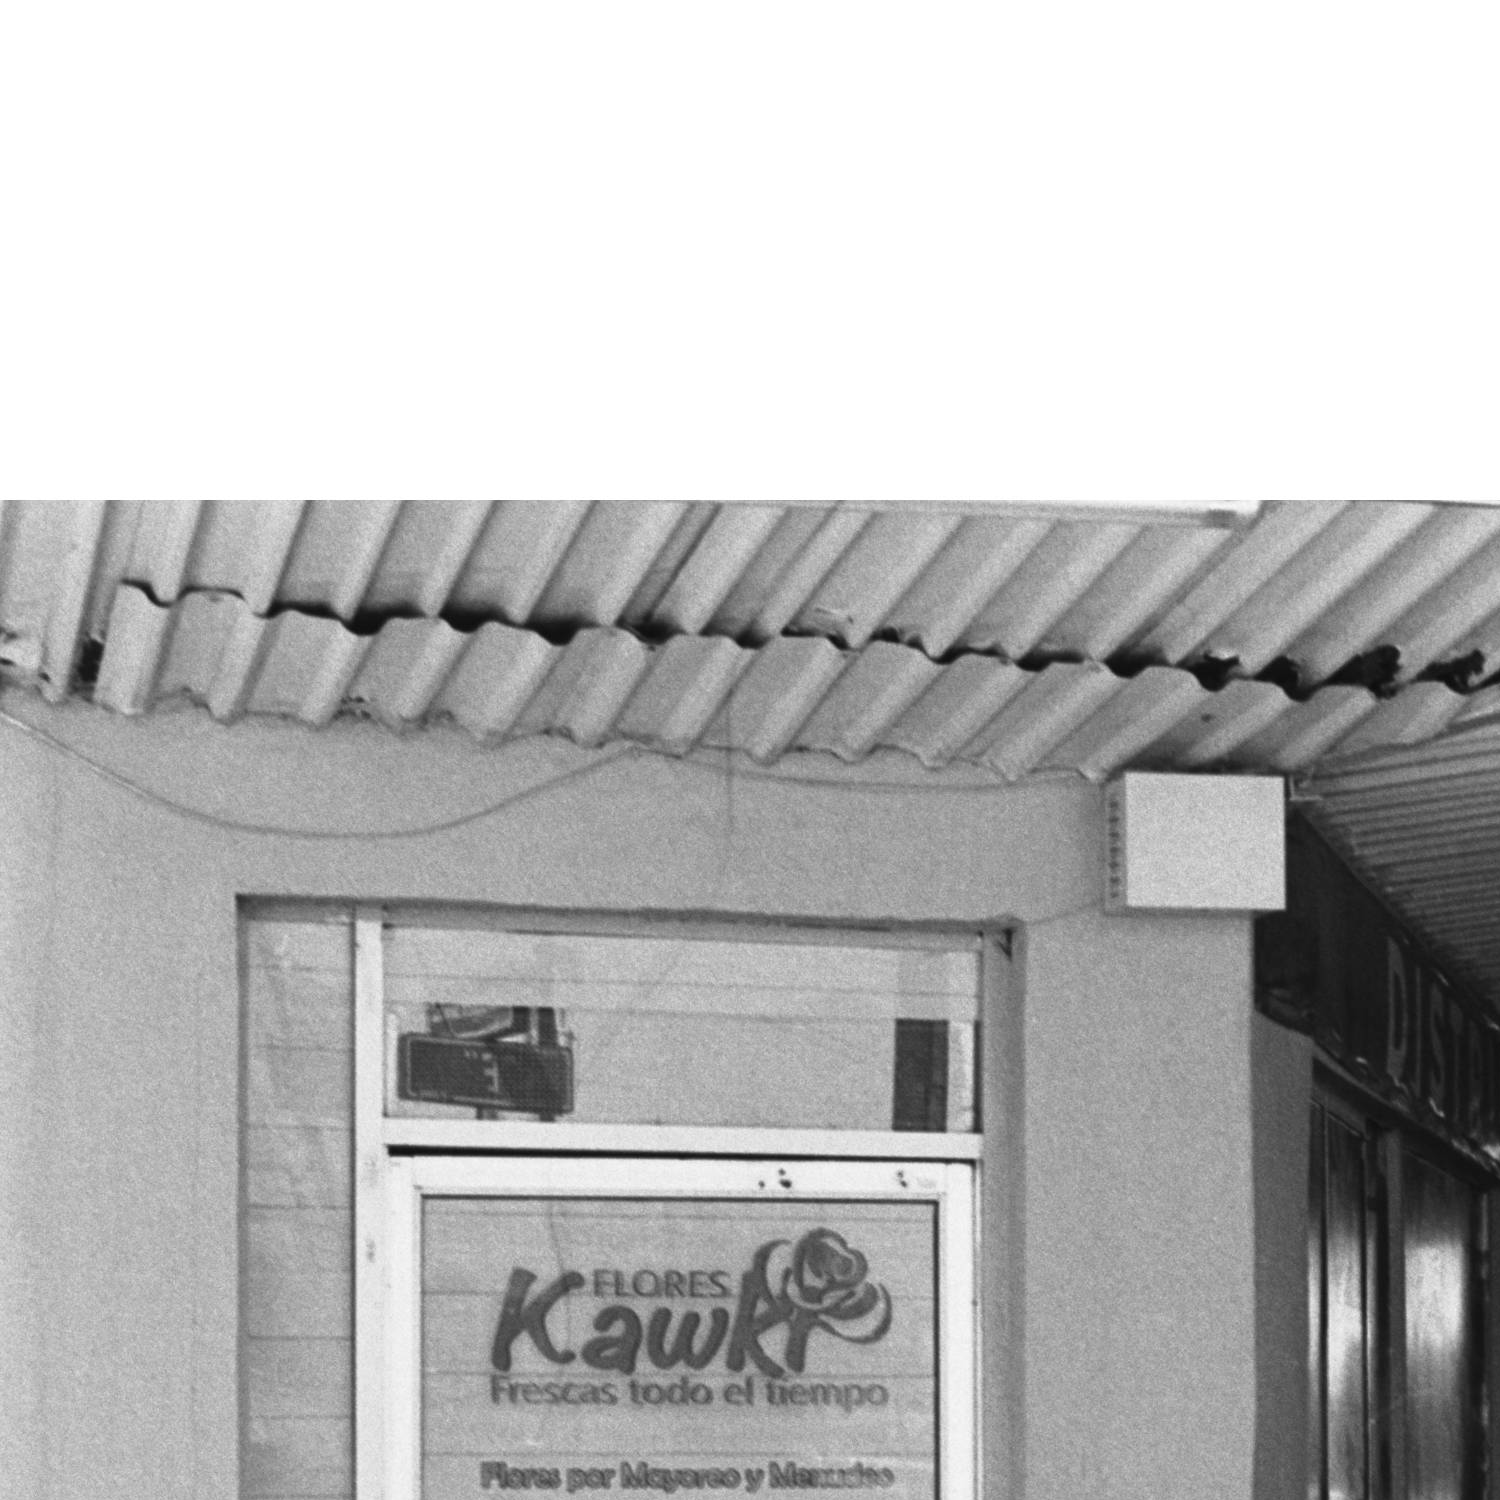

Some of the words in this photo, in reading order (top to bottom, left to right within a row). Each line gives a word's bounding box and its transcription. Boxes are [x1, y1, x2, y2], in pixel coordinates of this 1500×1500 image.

[592, 1268, 732, 1299] FLORES
[489, 1374, 619, 1407] Frescas
[627, 1376, 714, 1407] todo
[723, 1374, 755, 1406] el
[764, 1375, 890, 1413] tiempo
[479, 1460, 563, 1491] Flores
[565, 1466, 617, 1494] por
[619, 1460, 743, 1494] Mayoreo
[744, 1467, 765, 1494] y
